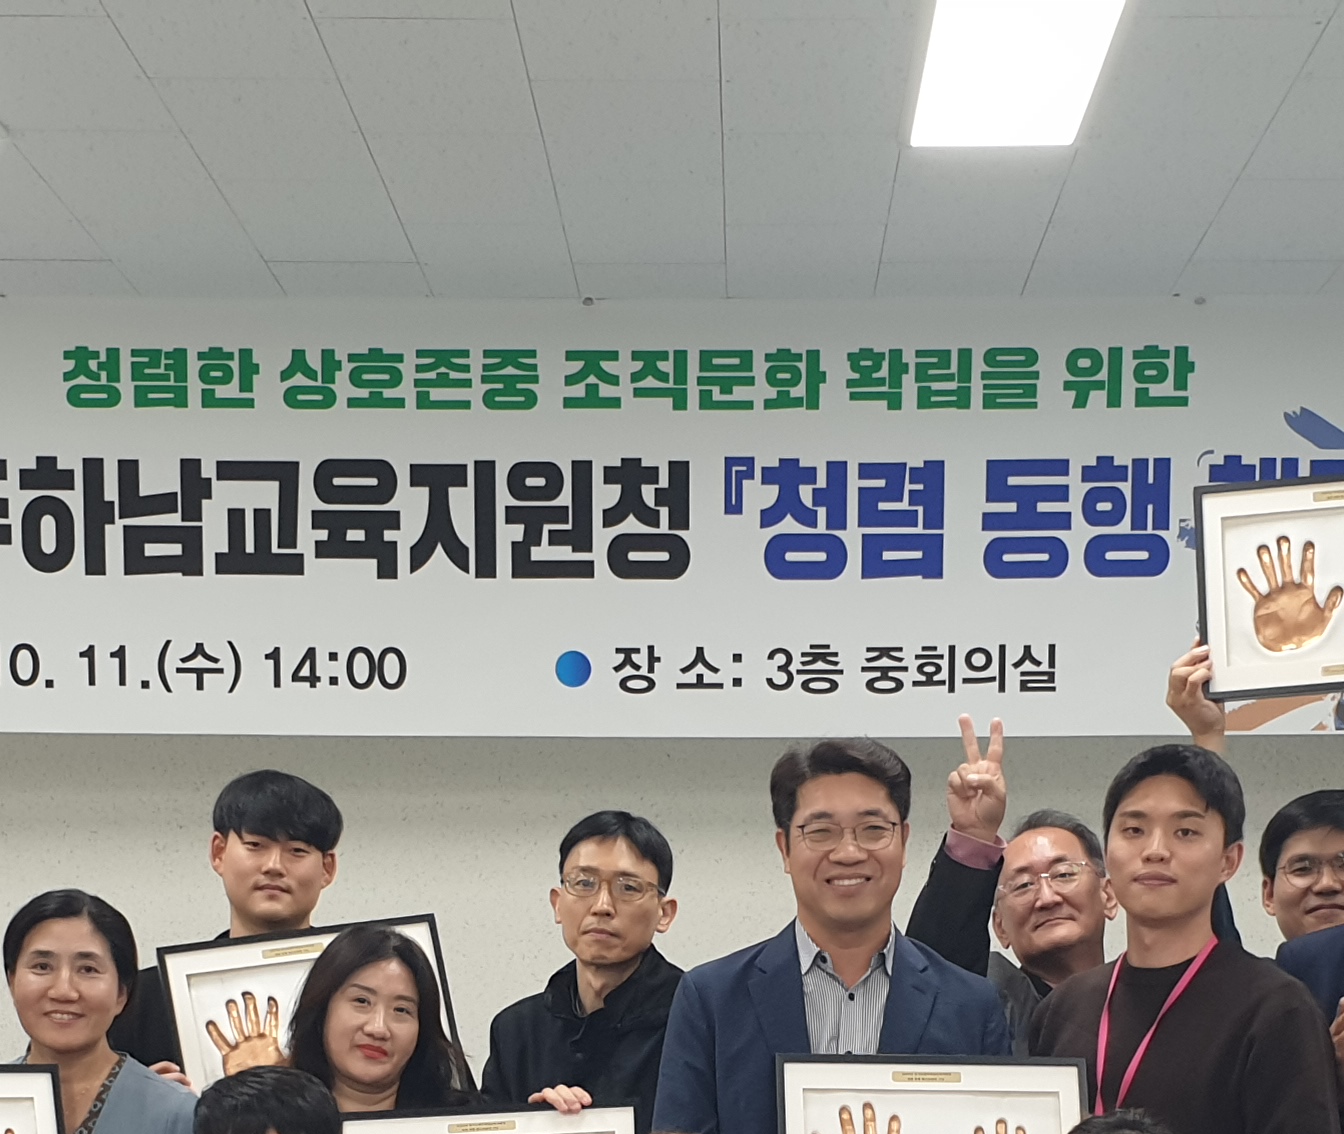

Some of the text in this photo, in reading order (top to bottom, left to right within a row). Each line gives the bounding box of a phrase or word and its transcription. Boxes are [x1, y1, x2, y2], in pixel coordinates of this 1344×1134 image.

[63, 345, 1195, 411] 청렴한 상호존중 조직문화 확립을 위한
[982, 456, 1171, 579] 동행
[79, 640, 241, 693] 11.(수)
[265, 646, 407, 690] 14:00
[612, 644, 1056, 694] 장 소: 3층 중회의실
